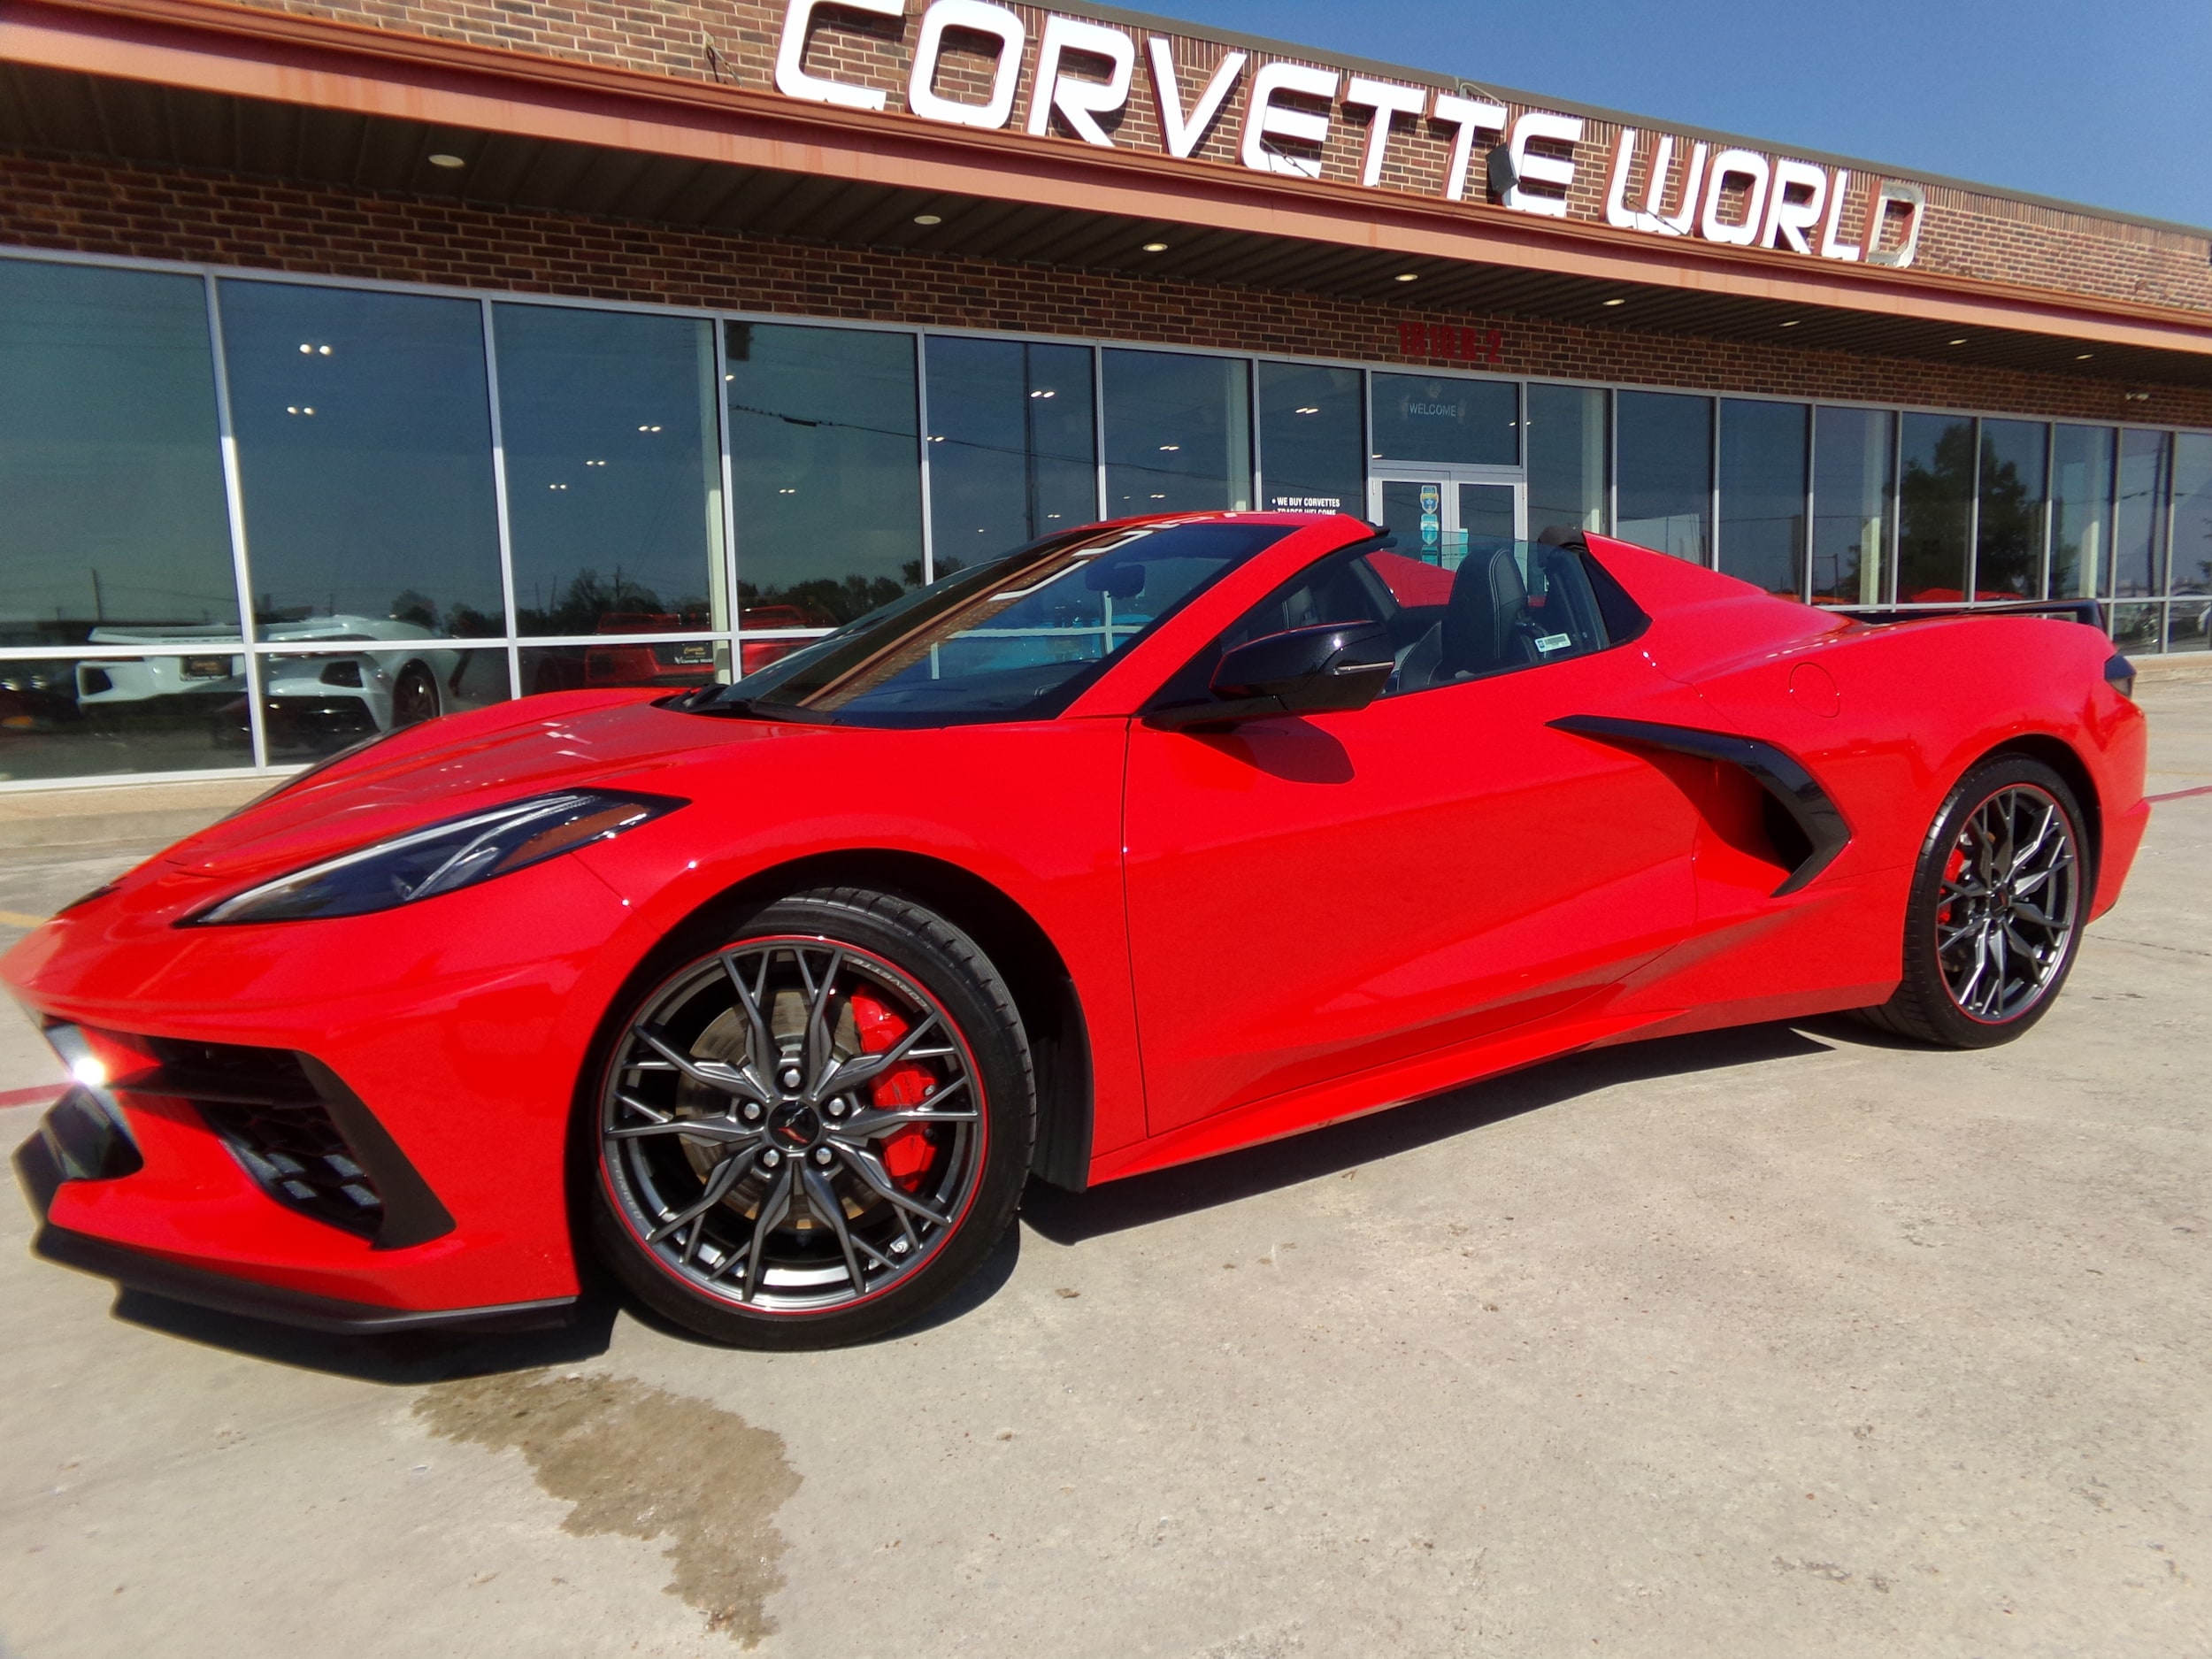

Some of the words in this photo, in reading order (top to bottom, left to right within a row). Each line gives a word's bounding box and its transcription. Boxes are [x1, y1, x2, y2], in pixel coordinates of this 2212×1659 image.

[775, 0, 1582, 218] CORVETTE
[1605, 130, 1925, 268] WORLD
[1398, 322, 1455, 358] 1810
[1409, 403, 1456, 417] WELCOME
[1277, 496, 1287, 506] WE
[1289, 497, 1302, 506] BUY
[1303, 498, 1340, 507] CORVETTES
[852, 958, 927, 1007] CORVETTE
